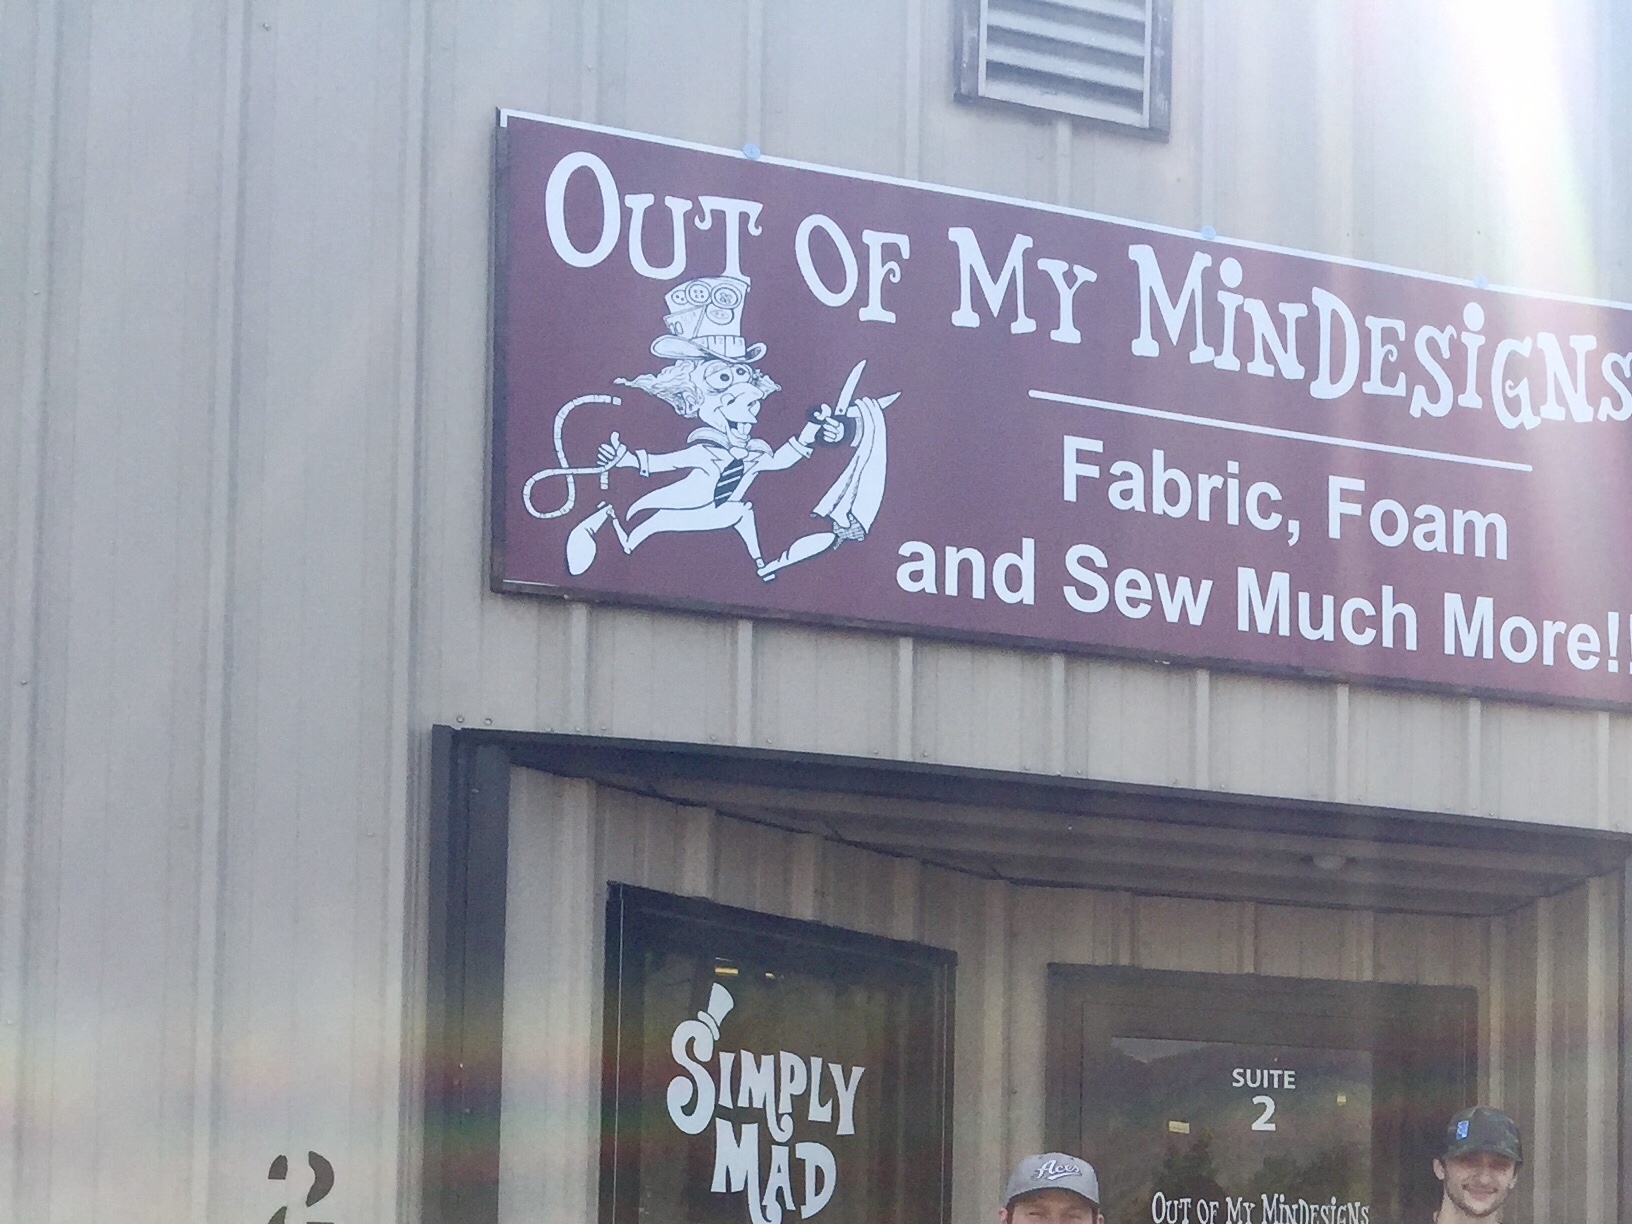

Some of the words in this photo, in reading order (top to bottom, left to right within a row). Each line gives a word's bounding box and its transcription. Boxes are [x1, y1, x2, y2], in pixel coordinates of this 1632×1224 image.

[544, 150, 763, 287] OUT
[794, 213, 911, 324] OF
[947, 226, 1098, 344] MY
[1063, 435, 1300, 546] Fabric,
[1328, 474, 1508, 560] Foam
[896, 538, 1035, 606] and
[1062, 543, 1214, 626] Sew
[1237, 566, 1418, 651] Much
[667, 1019, 866, 1144] SIMPLY
[1231, 1068, 1296, 1089] SUITE
[1251, 1095, 1276, 1131] 2
[1036, 1159, 1080, 1179] Aces
